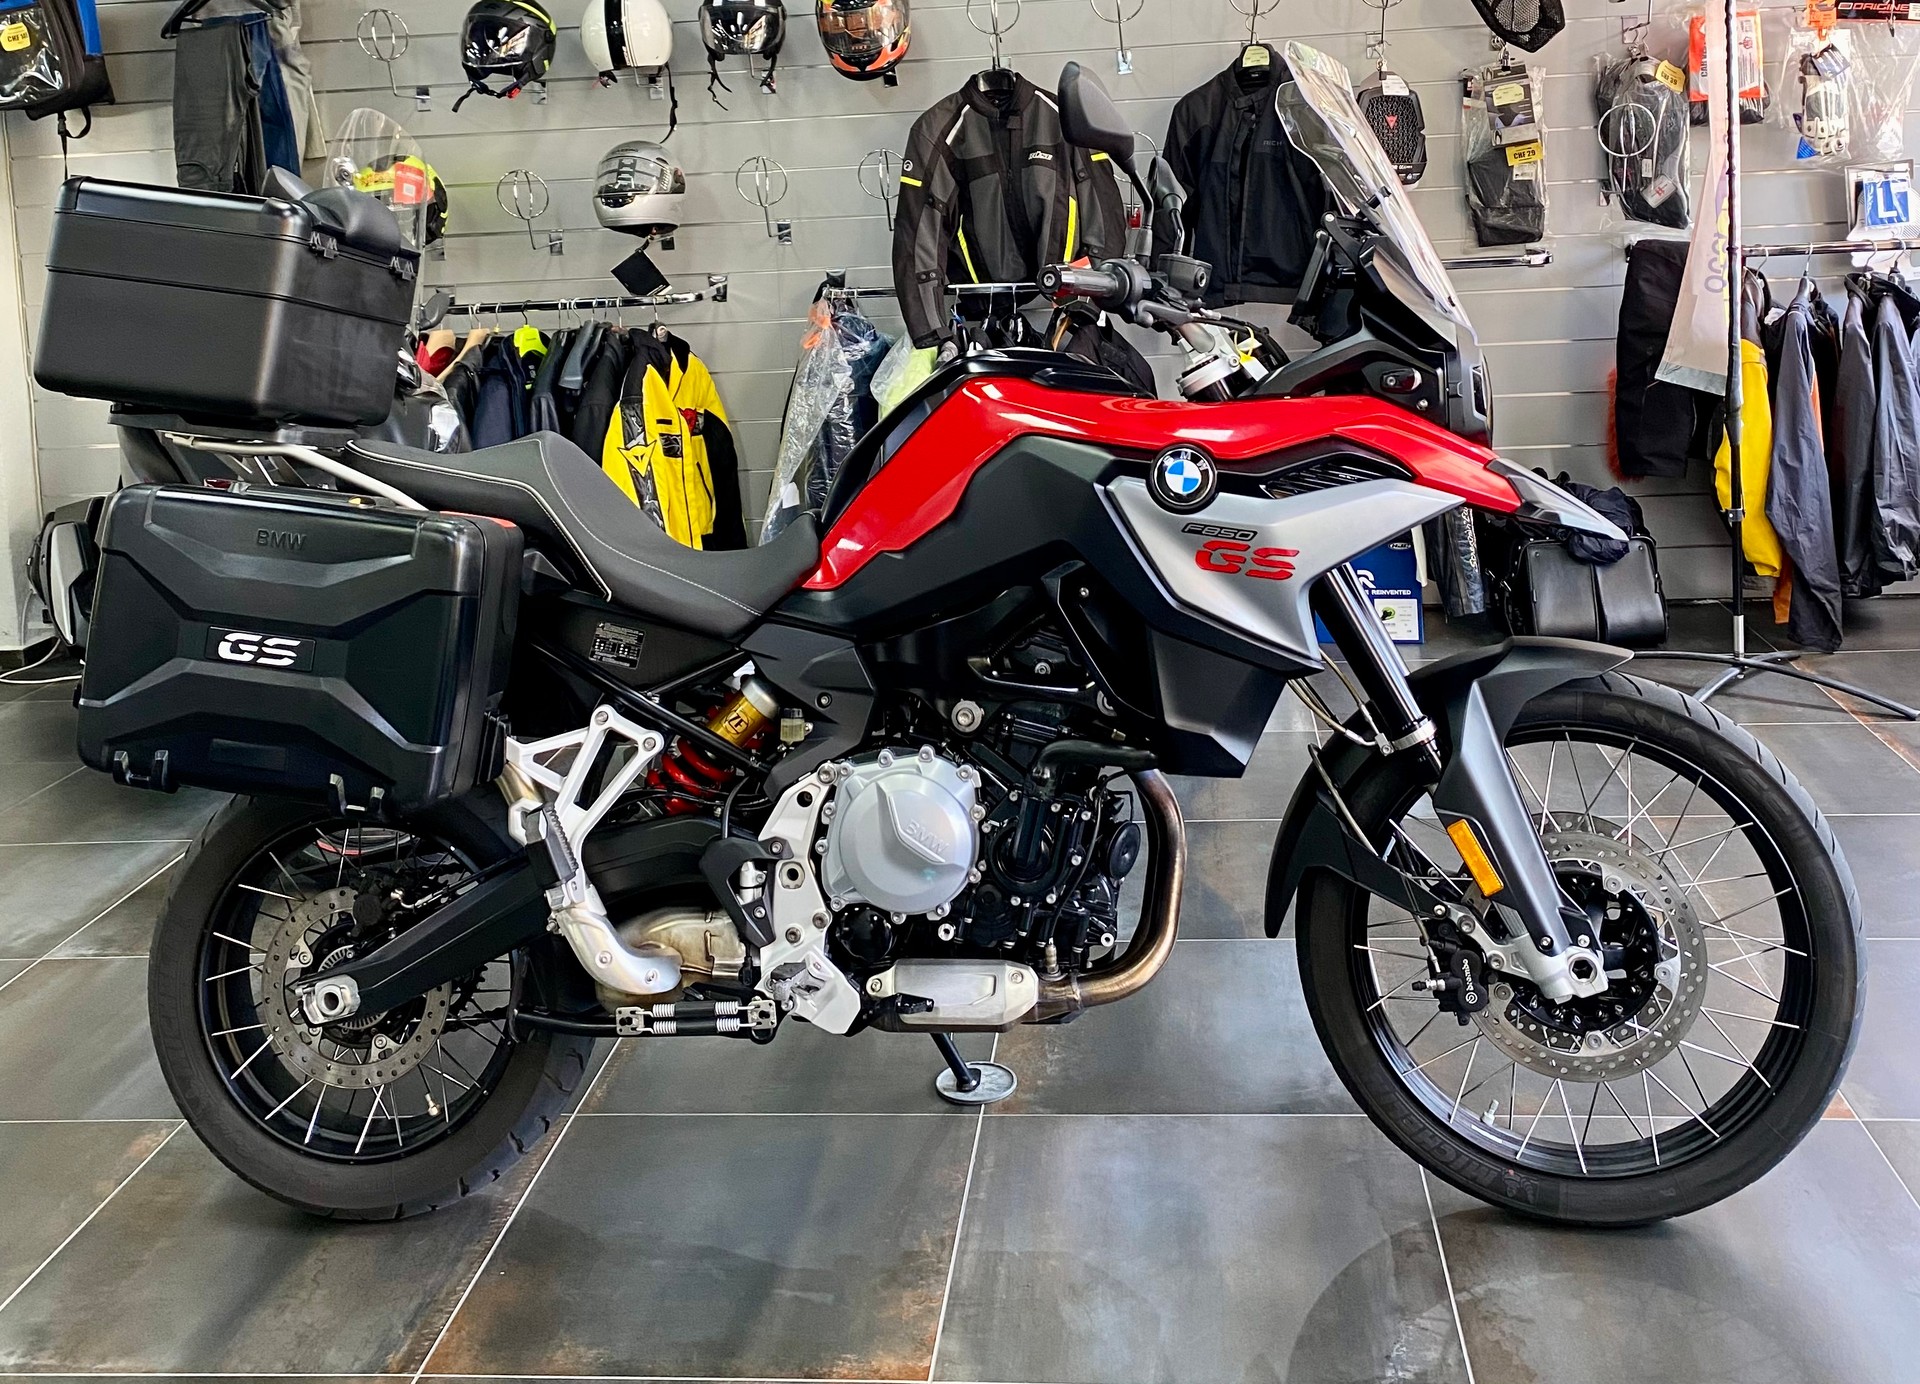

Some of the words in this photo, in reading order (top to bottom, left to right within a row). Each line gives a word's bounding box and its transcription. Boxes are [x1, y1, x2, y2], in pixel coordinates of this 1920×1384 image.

[1513, 150, 1526, 160] CHF
[256, 528, 308, 550] BMW
[1195, 539, 1300, 580] GS
[218, 632, 301, 666] GS
[905, 819, 950, 854] BMW
